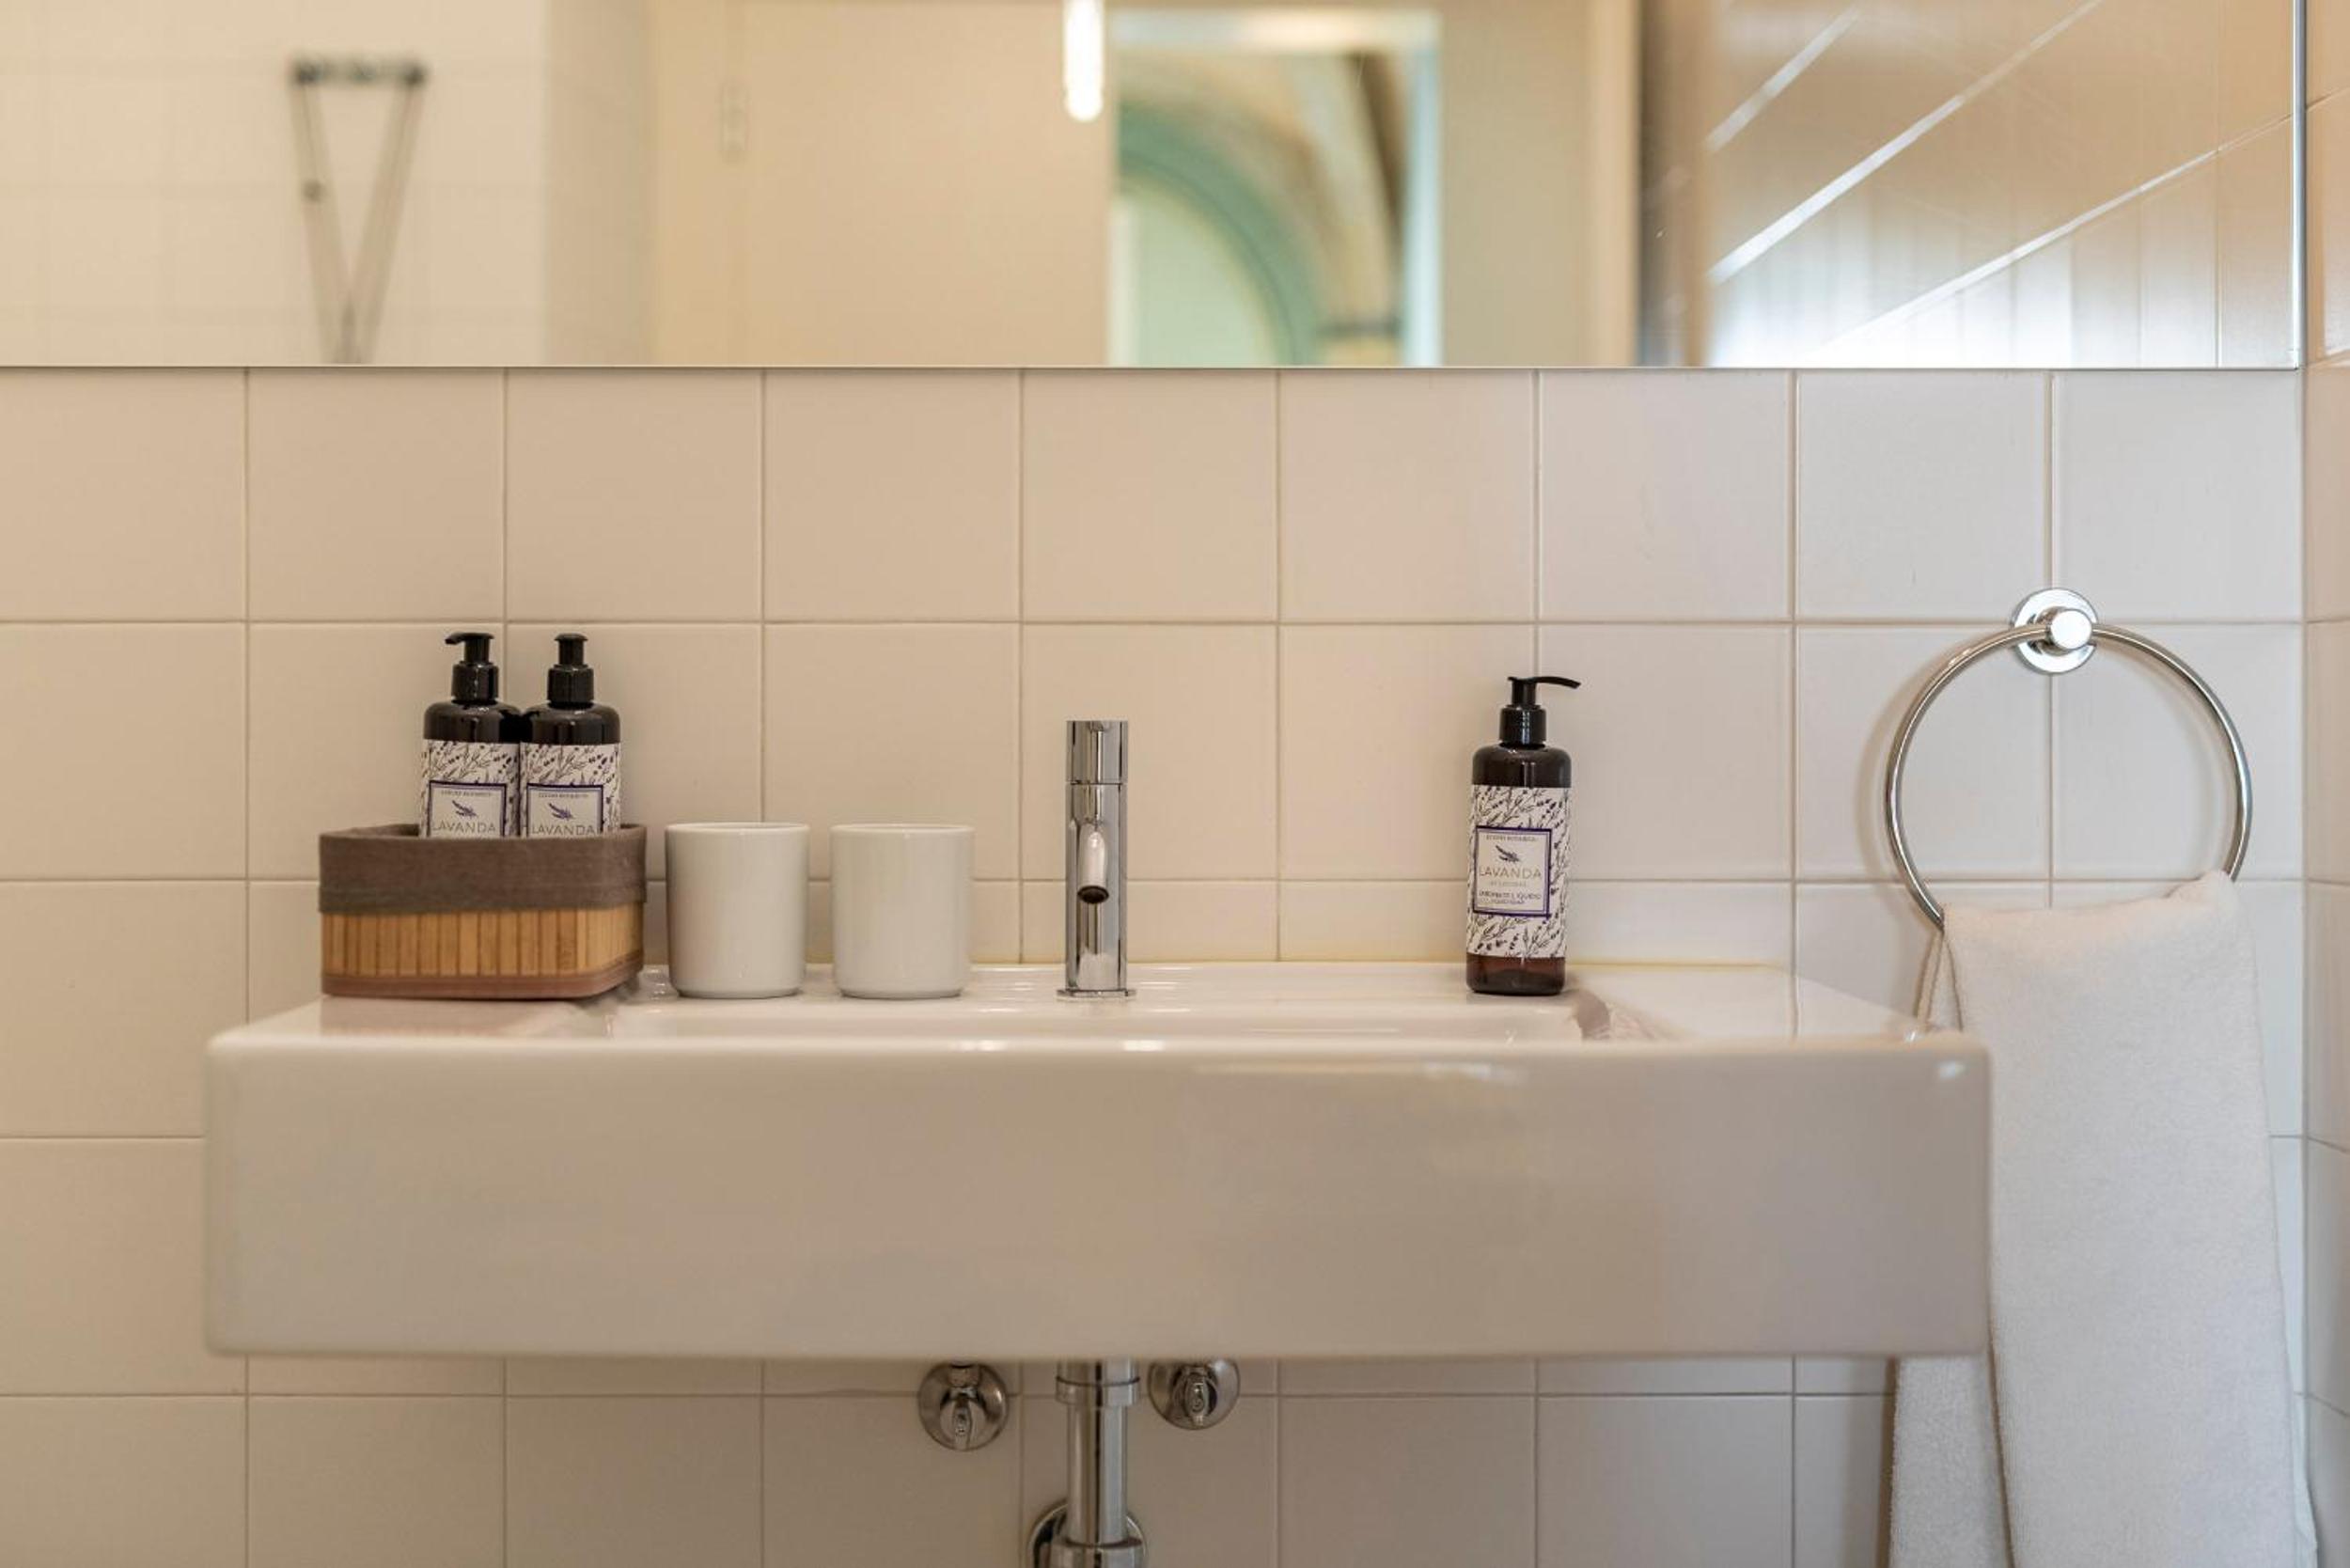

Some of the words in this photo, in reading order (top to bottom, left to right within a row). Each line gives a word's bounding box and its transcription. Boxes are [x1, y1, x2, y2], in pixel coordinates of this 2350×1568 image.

[431, 819, 495, 834] LAVANDA
[531, 823, 596, 837] LAVANDA
[1478, 866, 1542, 880] LAVANDA
